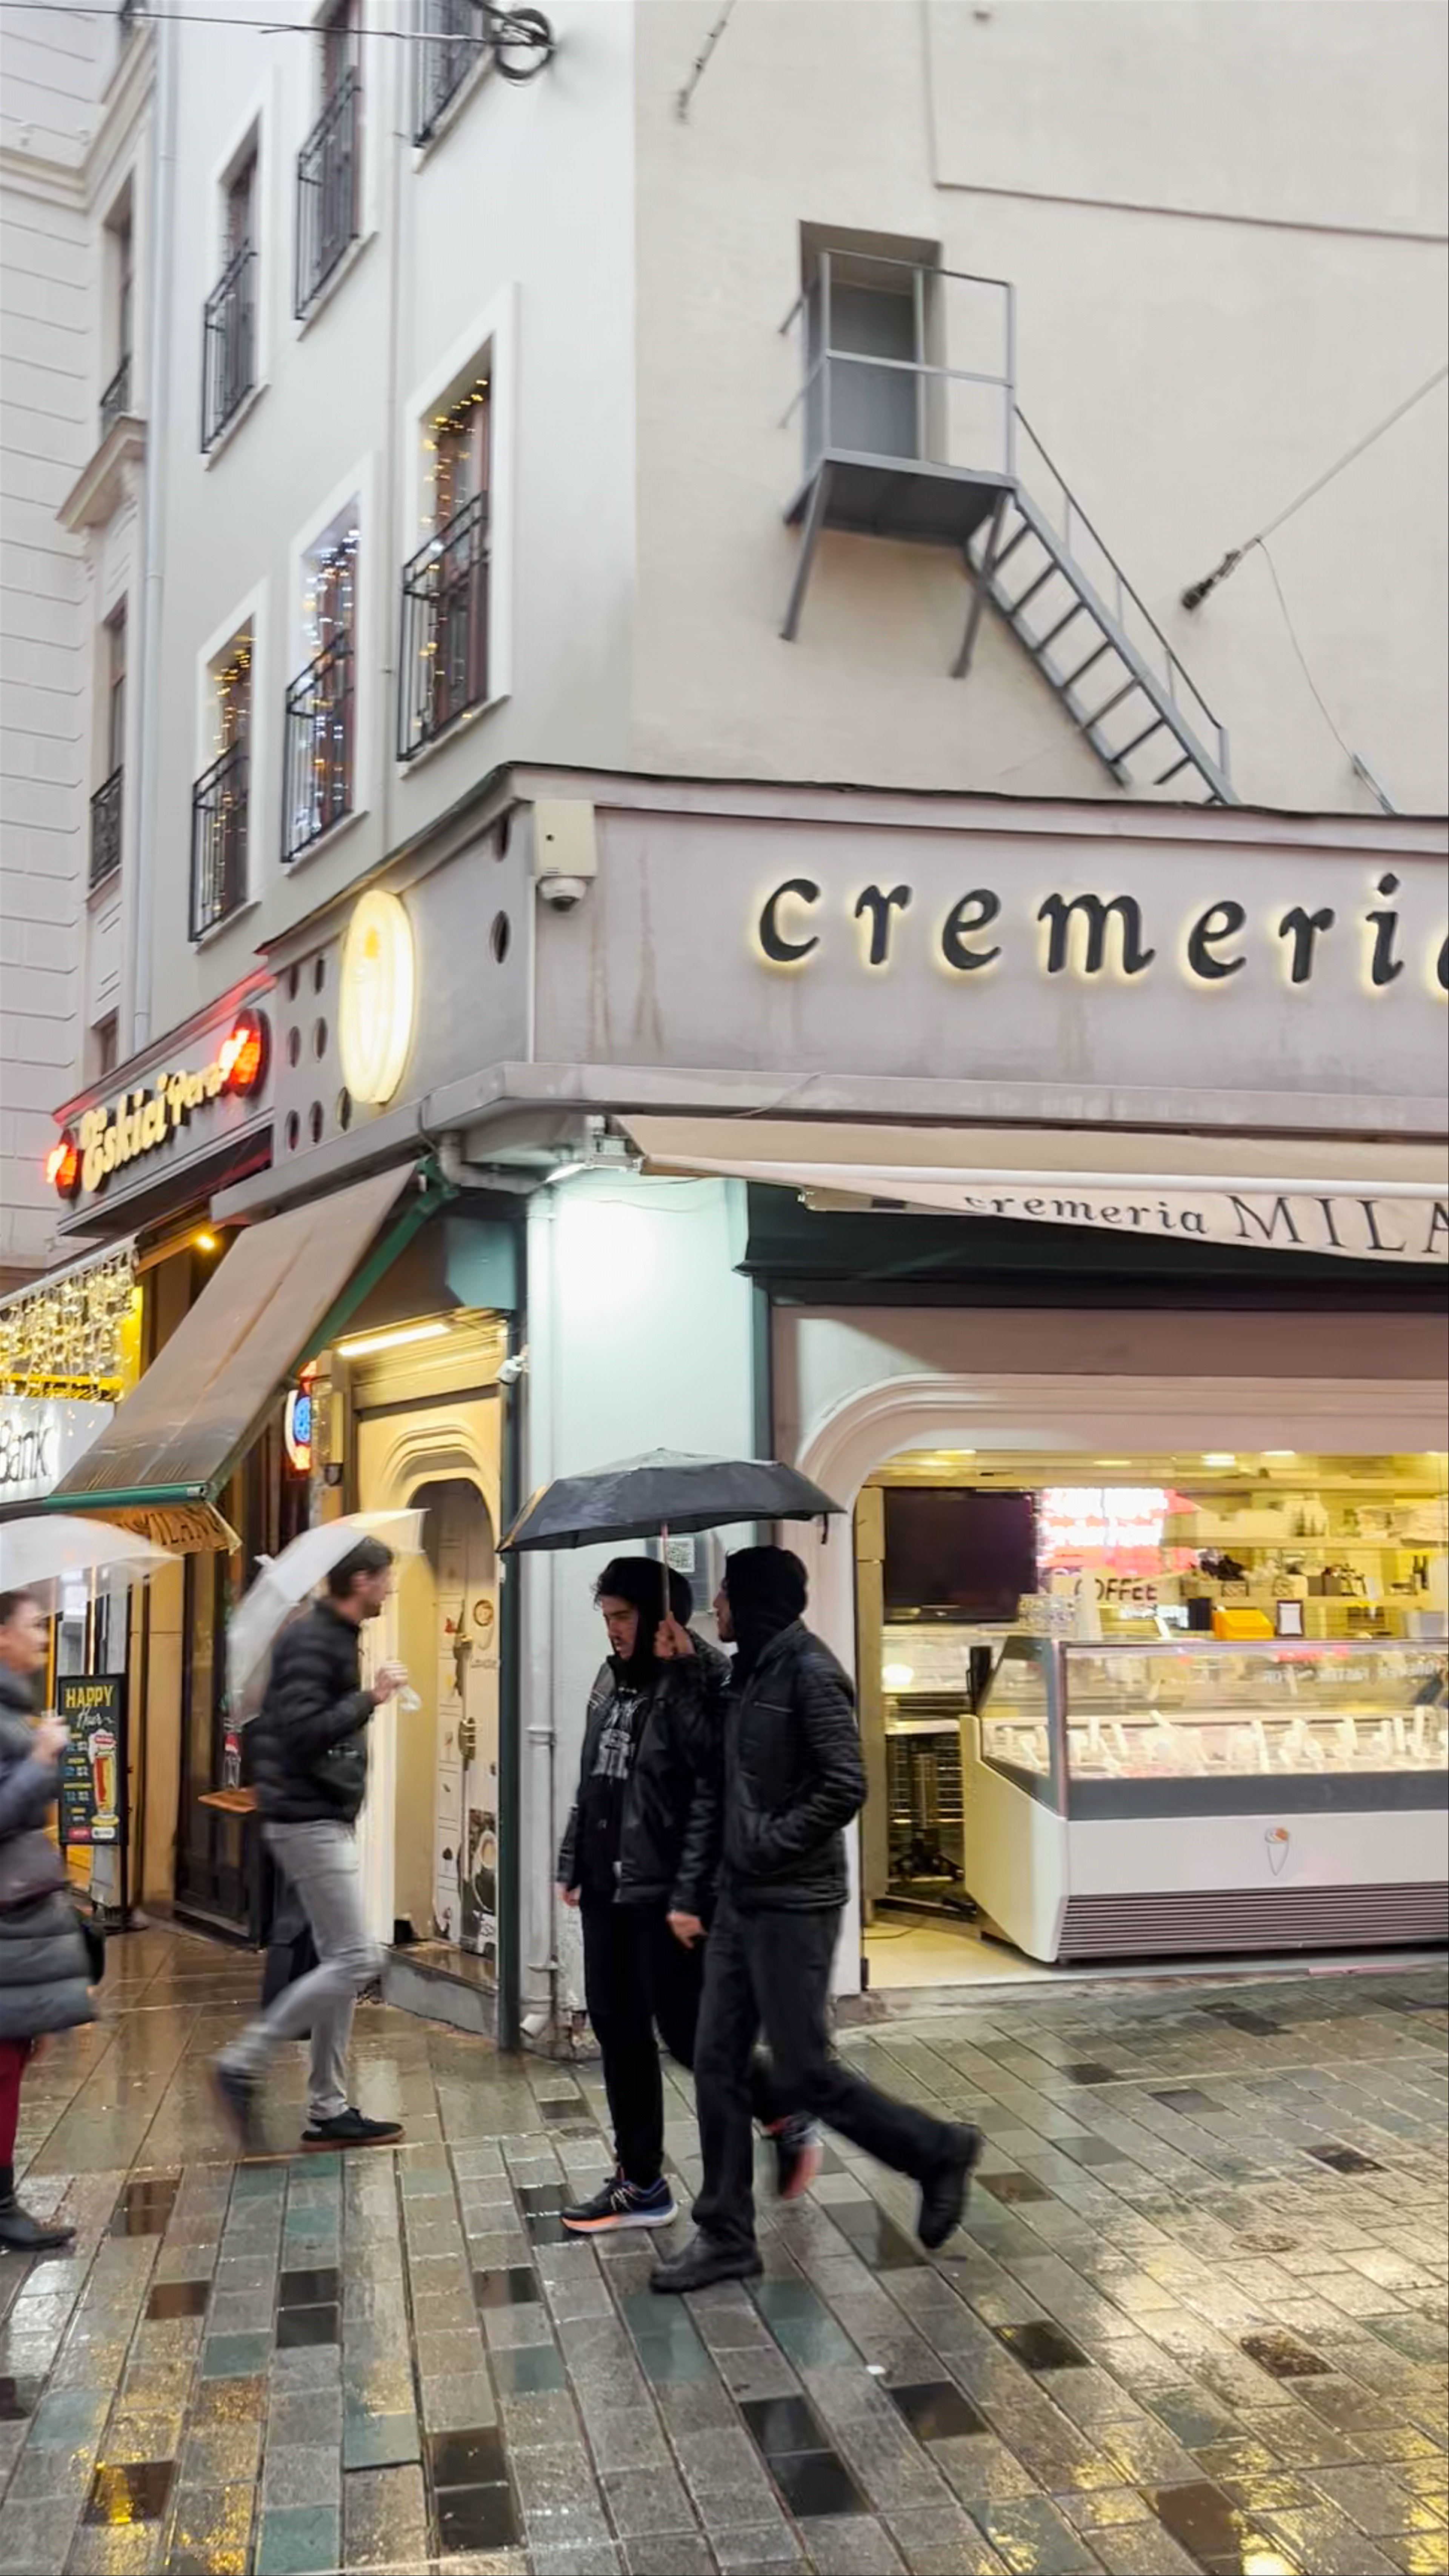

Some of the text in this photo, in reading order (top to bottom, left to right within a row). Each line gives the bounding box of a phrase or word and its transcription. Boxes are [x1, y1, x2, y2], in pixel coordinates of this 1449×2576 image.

[759, 873, 1449, 990] cremeri
[964, 1196, 1208, 1234] cremeria
[66, 1686, 113, 1708] HAPPY
